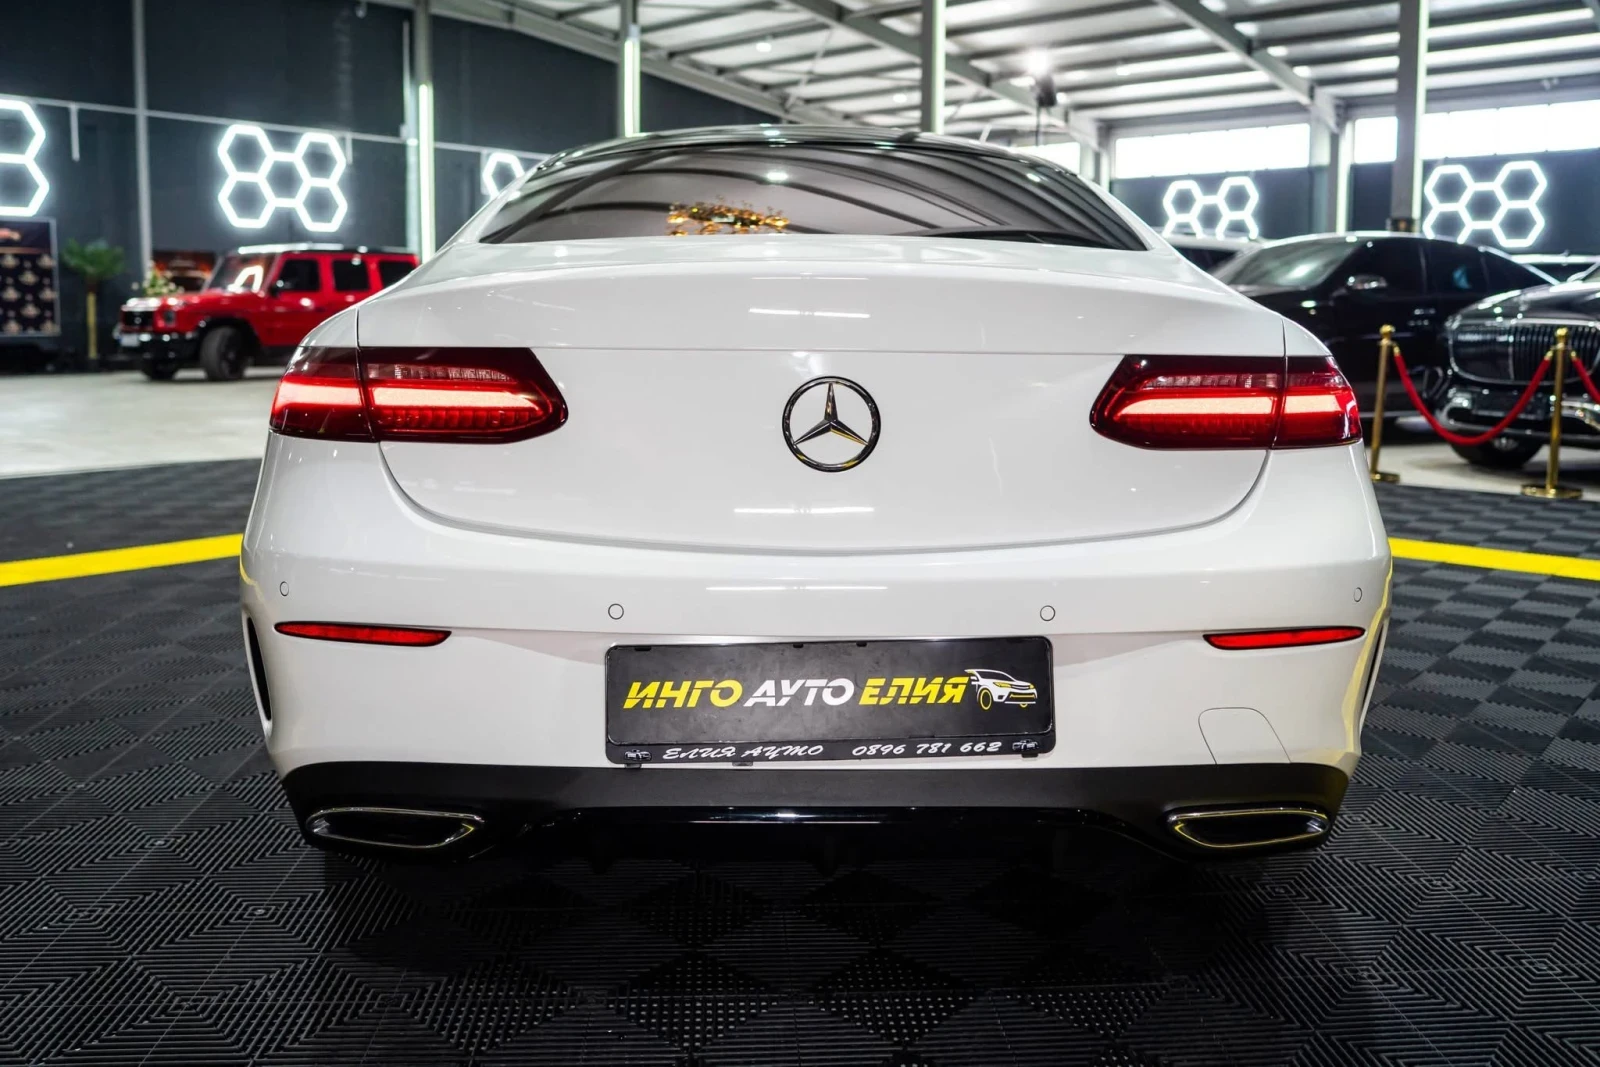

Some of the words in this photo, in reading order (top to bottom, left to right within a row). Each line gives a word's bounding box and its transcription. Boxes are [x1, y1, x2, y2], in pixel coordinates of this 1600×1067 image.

[622, 679, 743, 709] ИНГО
[742, 677, 855, 707] АУТО
[858, 676, 970, 706] ЕЛИЯ
[662, 746, 736, 760] ЕЛИЯ
[851, 744, 906, 756] 0896
[915, 742, 953, 755] 781
[959, 740, 1003, 754] 662
